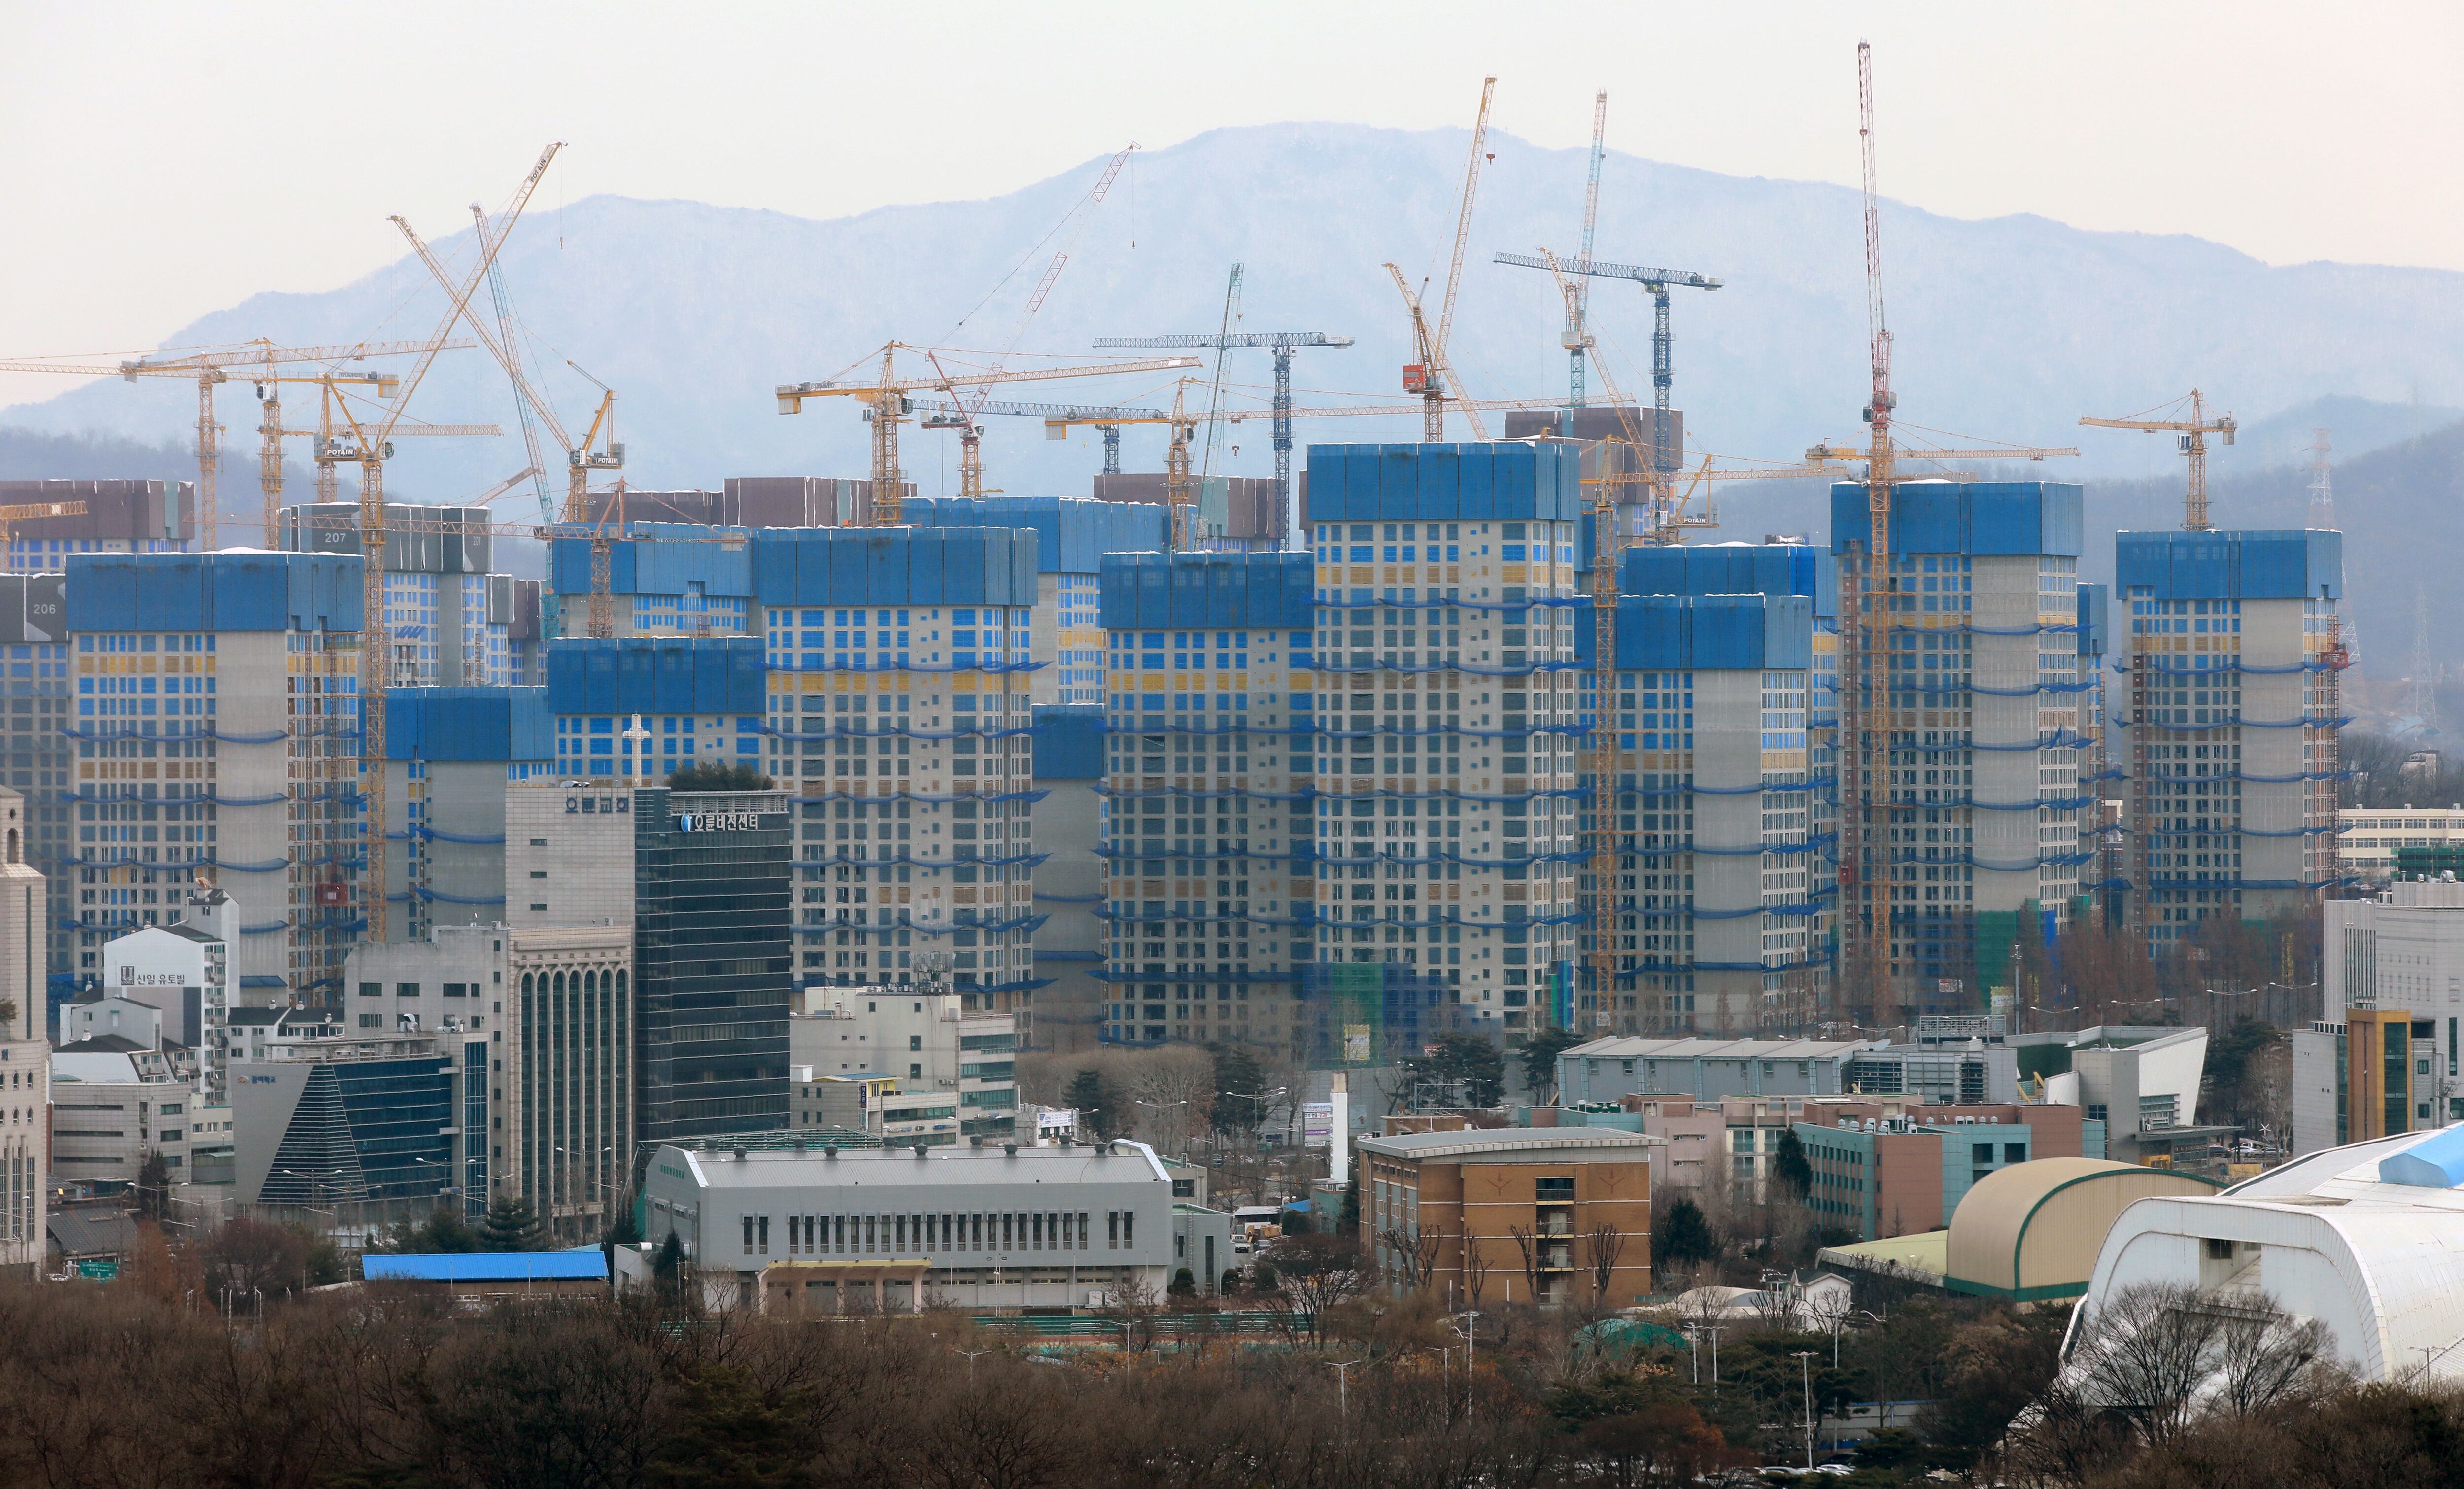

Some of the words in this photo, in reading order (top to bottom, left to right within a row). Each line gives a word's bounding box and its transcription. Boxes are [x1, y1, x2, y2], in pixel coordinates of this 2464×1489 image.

[530, 159, 547, 183] POTAIN
[1547, 252, 1559, 272] POTAIN
[1394, 266, 1405, 286] POTAIN
[325, 533, 346, 543] 207
[34, 604, 56, 614] 206
[566, 797, 629, 813] 오륜교회
[695, 814, 758, 831] 오륜비전센터
[137, 974, 155, 985] 신일
[158, 974, 185, 985] 유토빌
